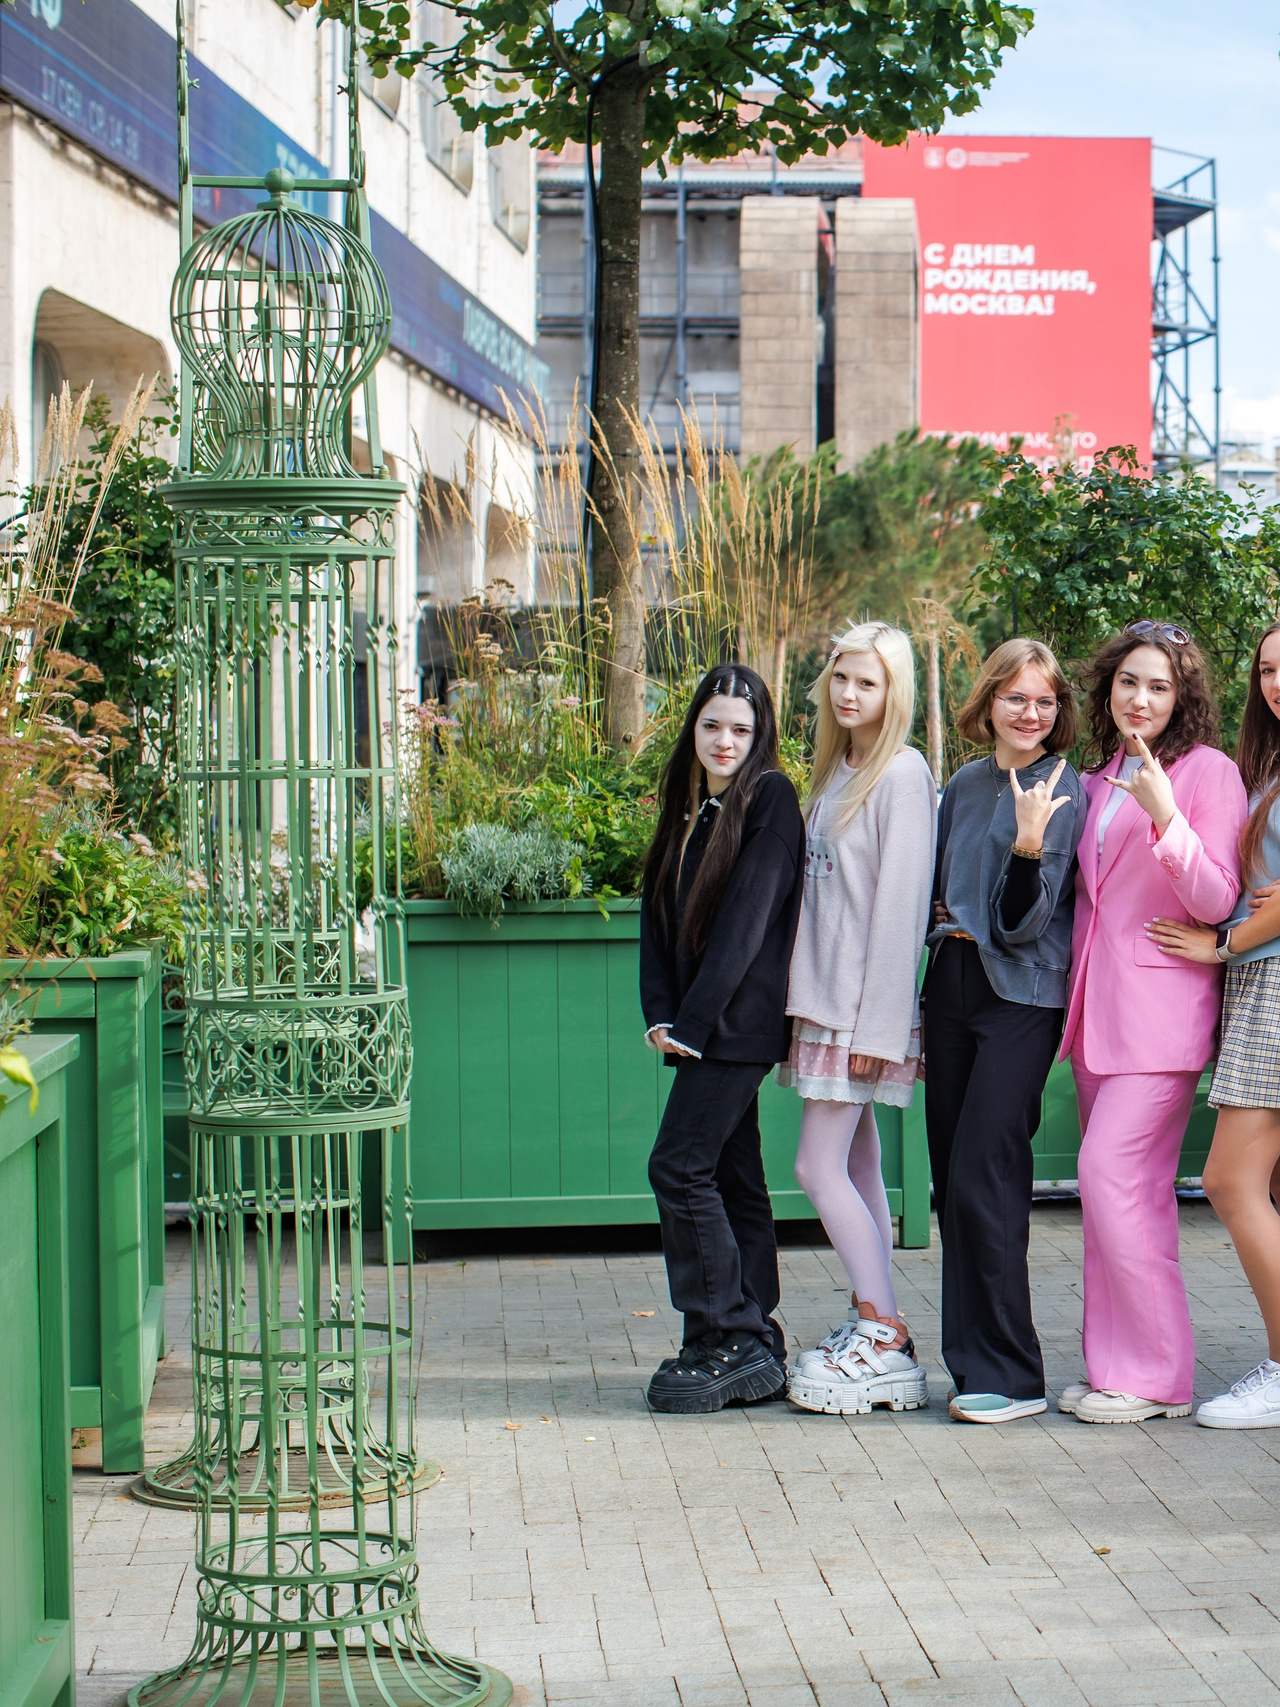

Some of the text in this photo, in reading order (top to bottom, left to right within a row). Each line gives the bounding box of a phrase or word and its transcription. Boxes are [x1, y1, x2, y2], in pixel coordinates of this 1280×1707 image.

[924, 243, 1035, 267] С ДНЕМ
[924, 268, 1097, 295] РОЖДЕНИЯ,
[924, 293, 1055, 316] МОСКВА!
